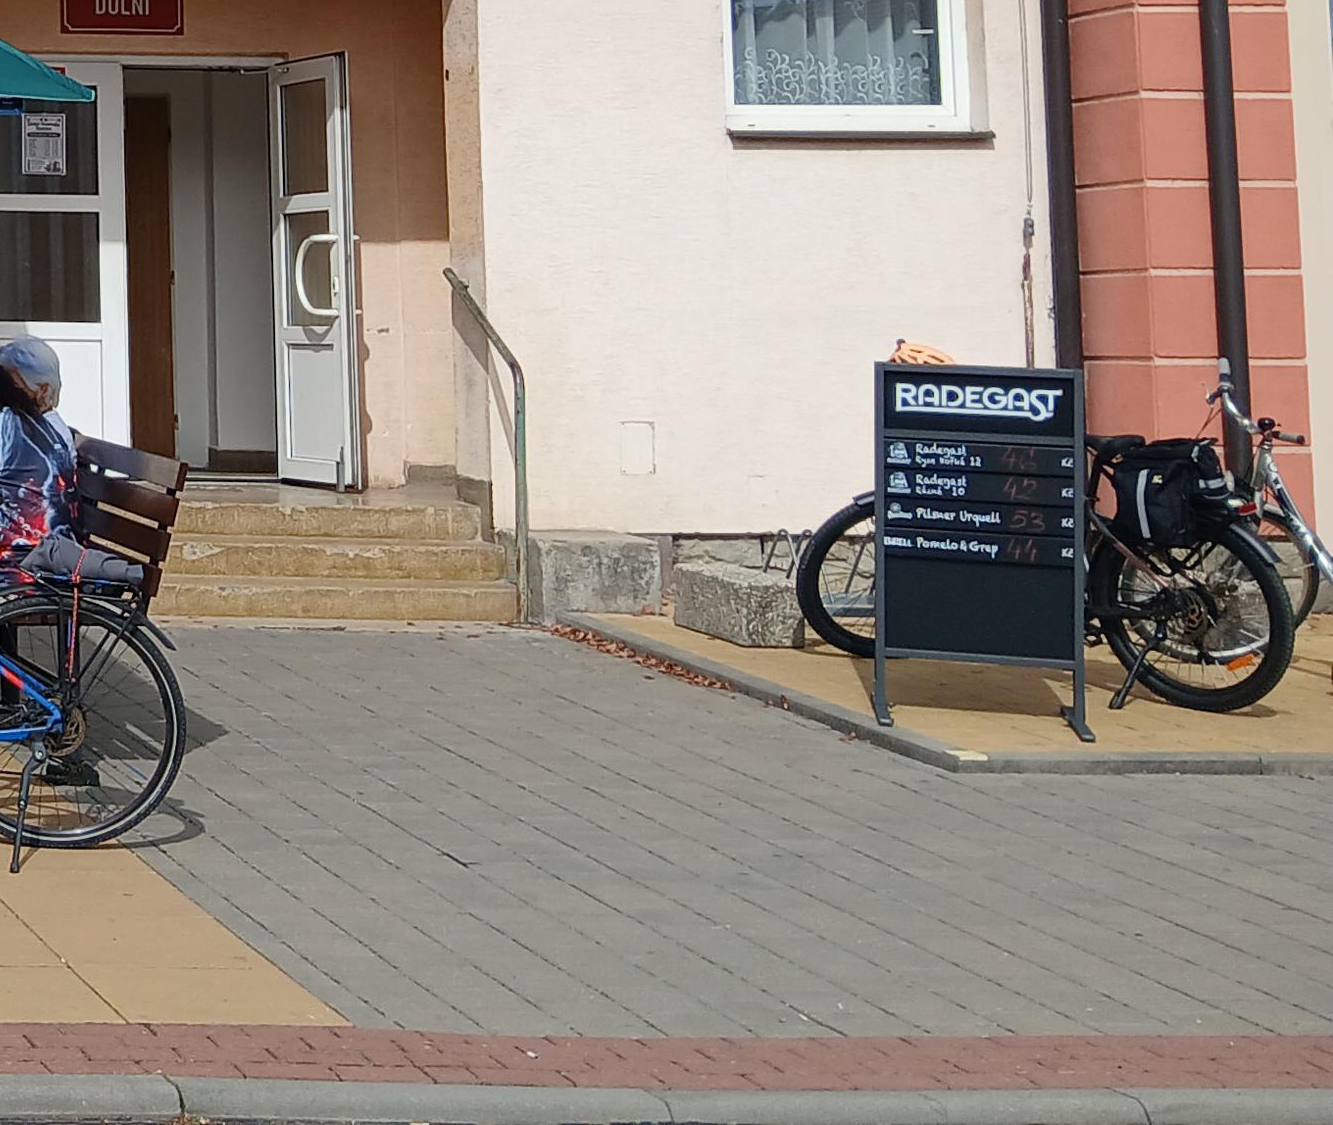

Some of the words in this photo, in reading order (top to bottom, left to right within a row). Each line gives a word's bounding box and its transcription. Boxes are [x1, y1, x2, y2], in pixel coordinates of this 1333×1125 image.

[895, 382, 1064, 422] RADEGAST
[915, 442, 967, 458] Radegast
[915, 473, 967, 490] Radegast
[952, 487, 966, 497] 10
[915, 507, 957, 521] Pilsner
[959, 509, 1002, 528] Urquell
[1010, 509, 1046, 532] 53
[915, 536, 959, 551] Pomelo
